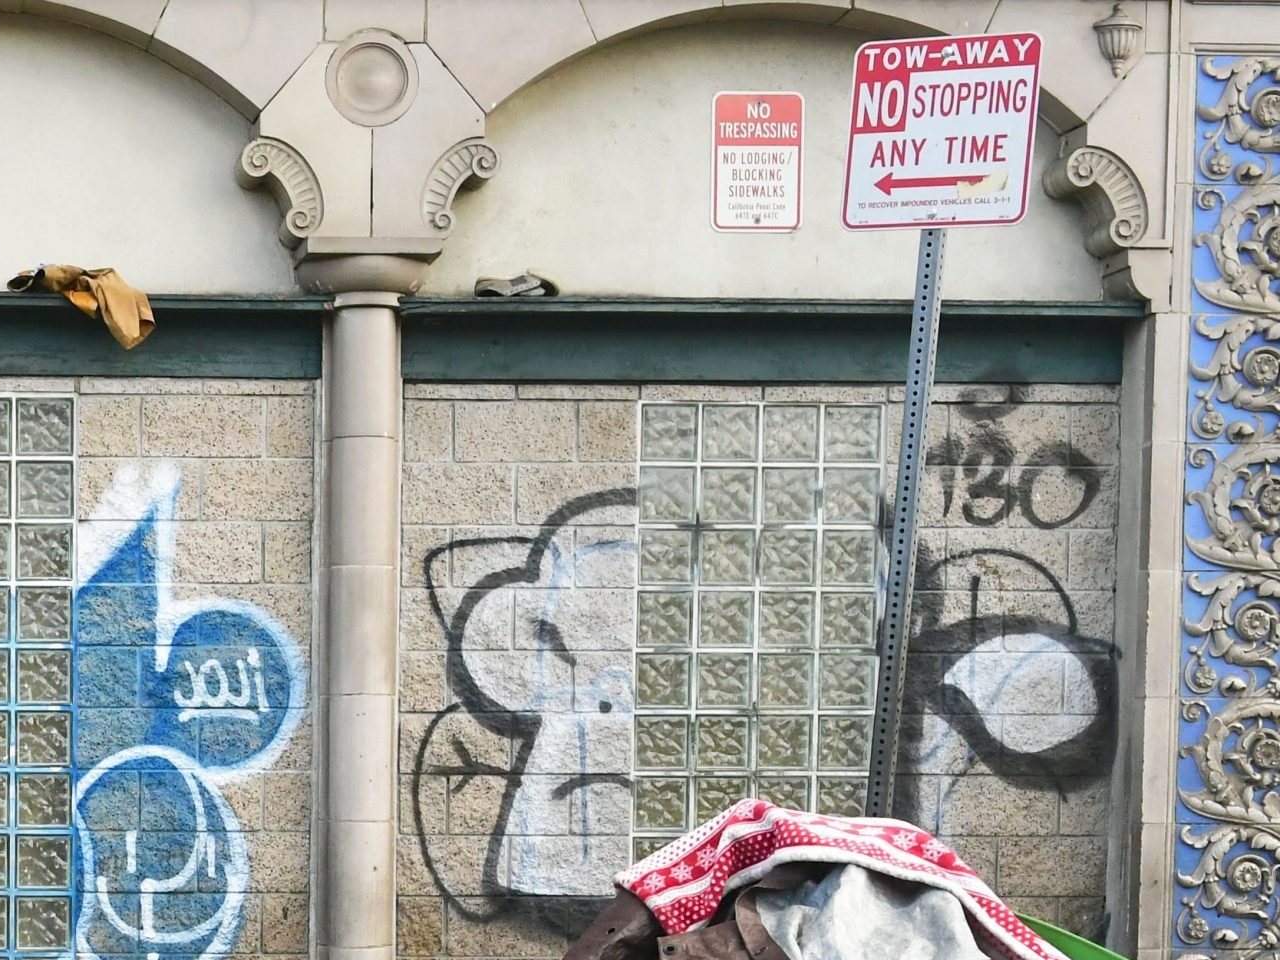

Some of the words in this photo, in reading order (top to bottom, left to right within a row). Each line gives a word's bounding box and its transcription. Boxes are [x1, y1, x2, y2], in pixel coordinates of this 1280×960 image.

[864, 37, 1035, 72] TOW-AWAY
[856, 79, 905, 128] NO
[912, 78, 1028, 119] STOPPING
[746, 102, 771, 119] NO
[719, 122, 798, 138] TRESPASSING
[722, 152, 737, 164] NO
[870, 138, 927, 168] ANY
[945, 134, 1008, 164] TIME
[731, 168, 782, 181] BLOCKING
[728, 185, 785, 198] SIDEWALKS
[727, 202, 754, 211] California
[772, 202, 786, 211] Code
[868, 201, 898, 209] RECOVER
[900, 200, 938, 208] IMPOUNDED
[940, 198, 971, 206] VEHICLES
[974, 197, 991, 205] CALL
